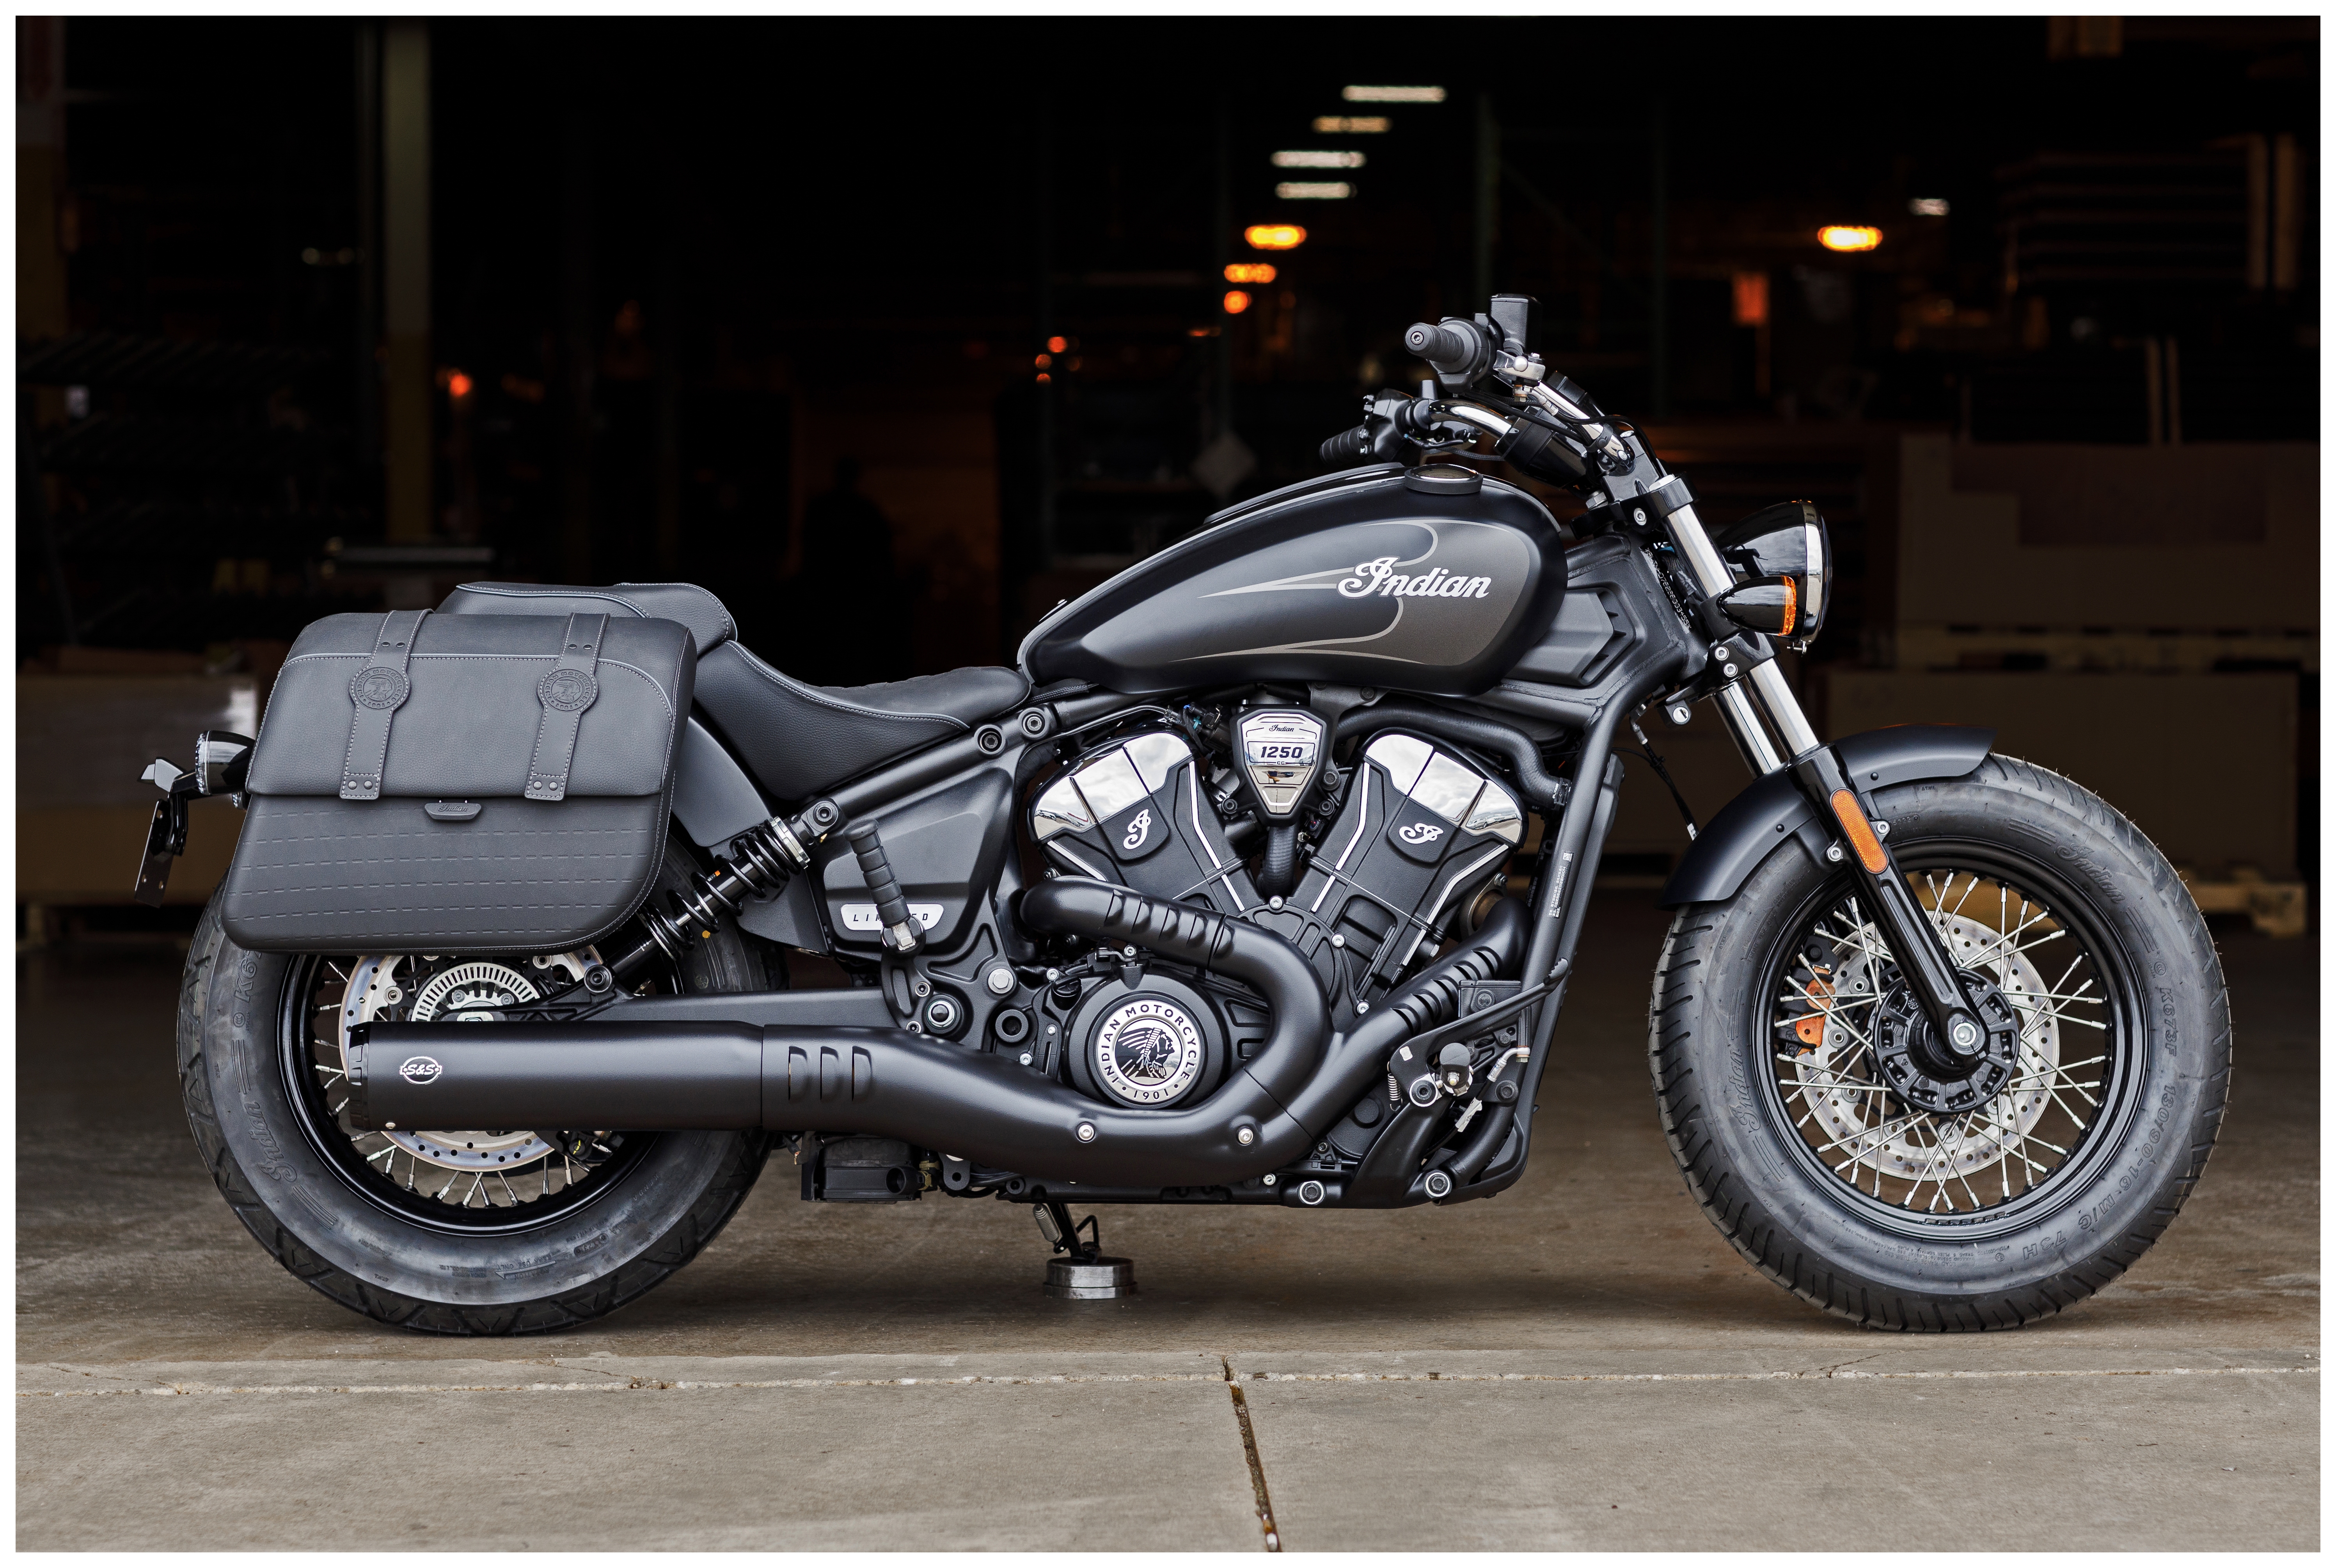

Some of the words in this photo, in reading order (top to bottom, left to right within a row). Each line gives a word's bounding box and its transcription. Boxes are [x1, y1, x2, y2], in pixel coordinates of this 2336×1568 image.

[1338, 557, 1492, 598] Indian
[357, 672, 371, 698] INDIAN
[373, 669, 403, 702] MOTORCYCLE
[545, 674, 559, 700] INDIAN
[561, 671, 590, 705] MOTORCYCLE
[1260, 746, 1303, 758] 1250
[2056, 842, 2126, 903] Indian
[1757, 926, 1768, 939] USE
[2160, 987, 2177, 1057] K673F
[1101, 1019, 1121, 1083] INDIAN
[1125, 1004, 1197, 1081] MOTORCYCLE
[405, 1064, 436, 1076] S&S
[1133, 1089, 1169, 1100] 1901
[1726, 1048, 1759, 1133] Indian
[244, 1101, 298, 1183] Indian
[632, 1173, 660, 1201] KENDA
[2078, 1193, 2116, 1230] M/C
[2023, 1230, 2067, 1260] 73H
